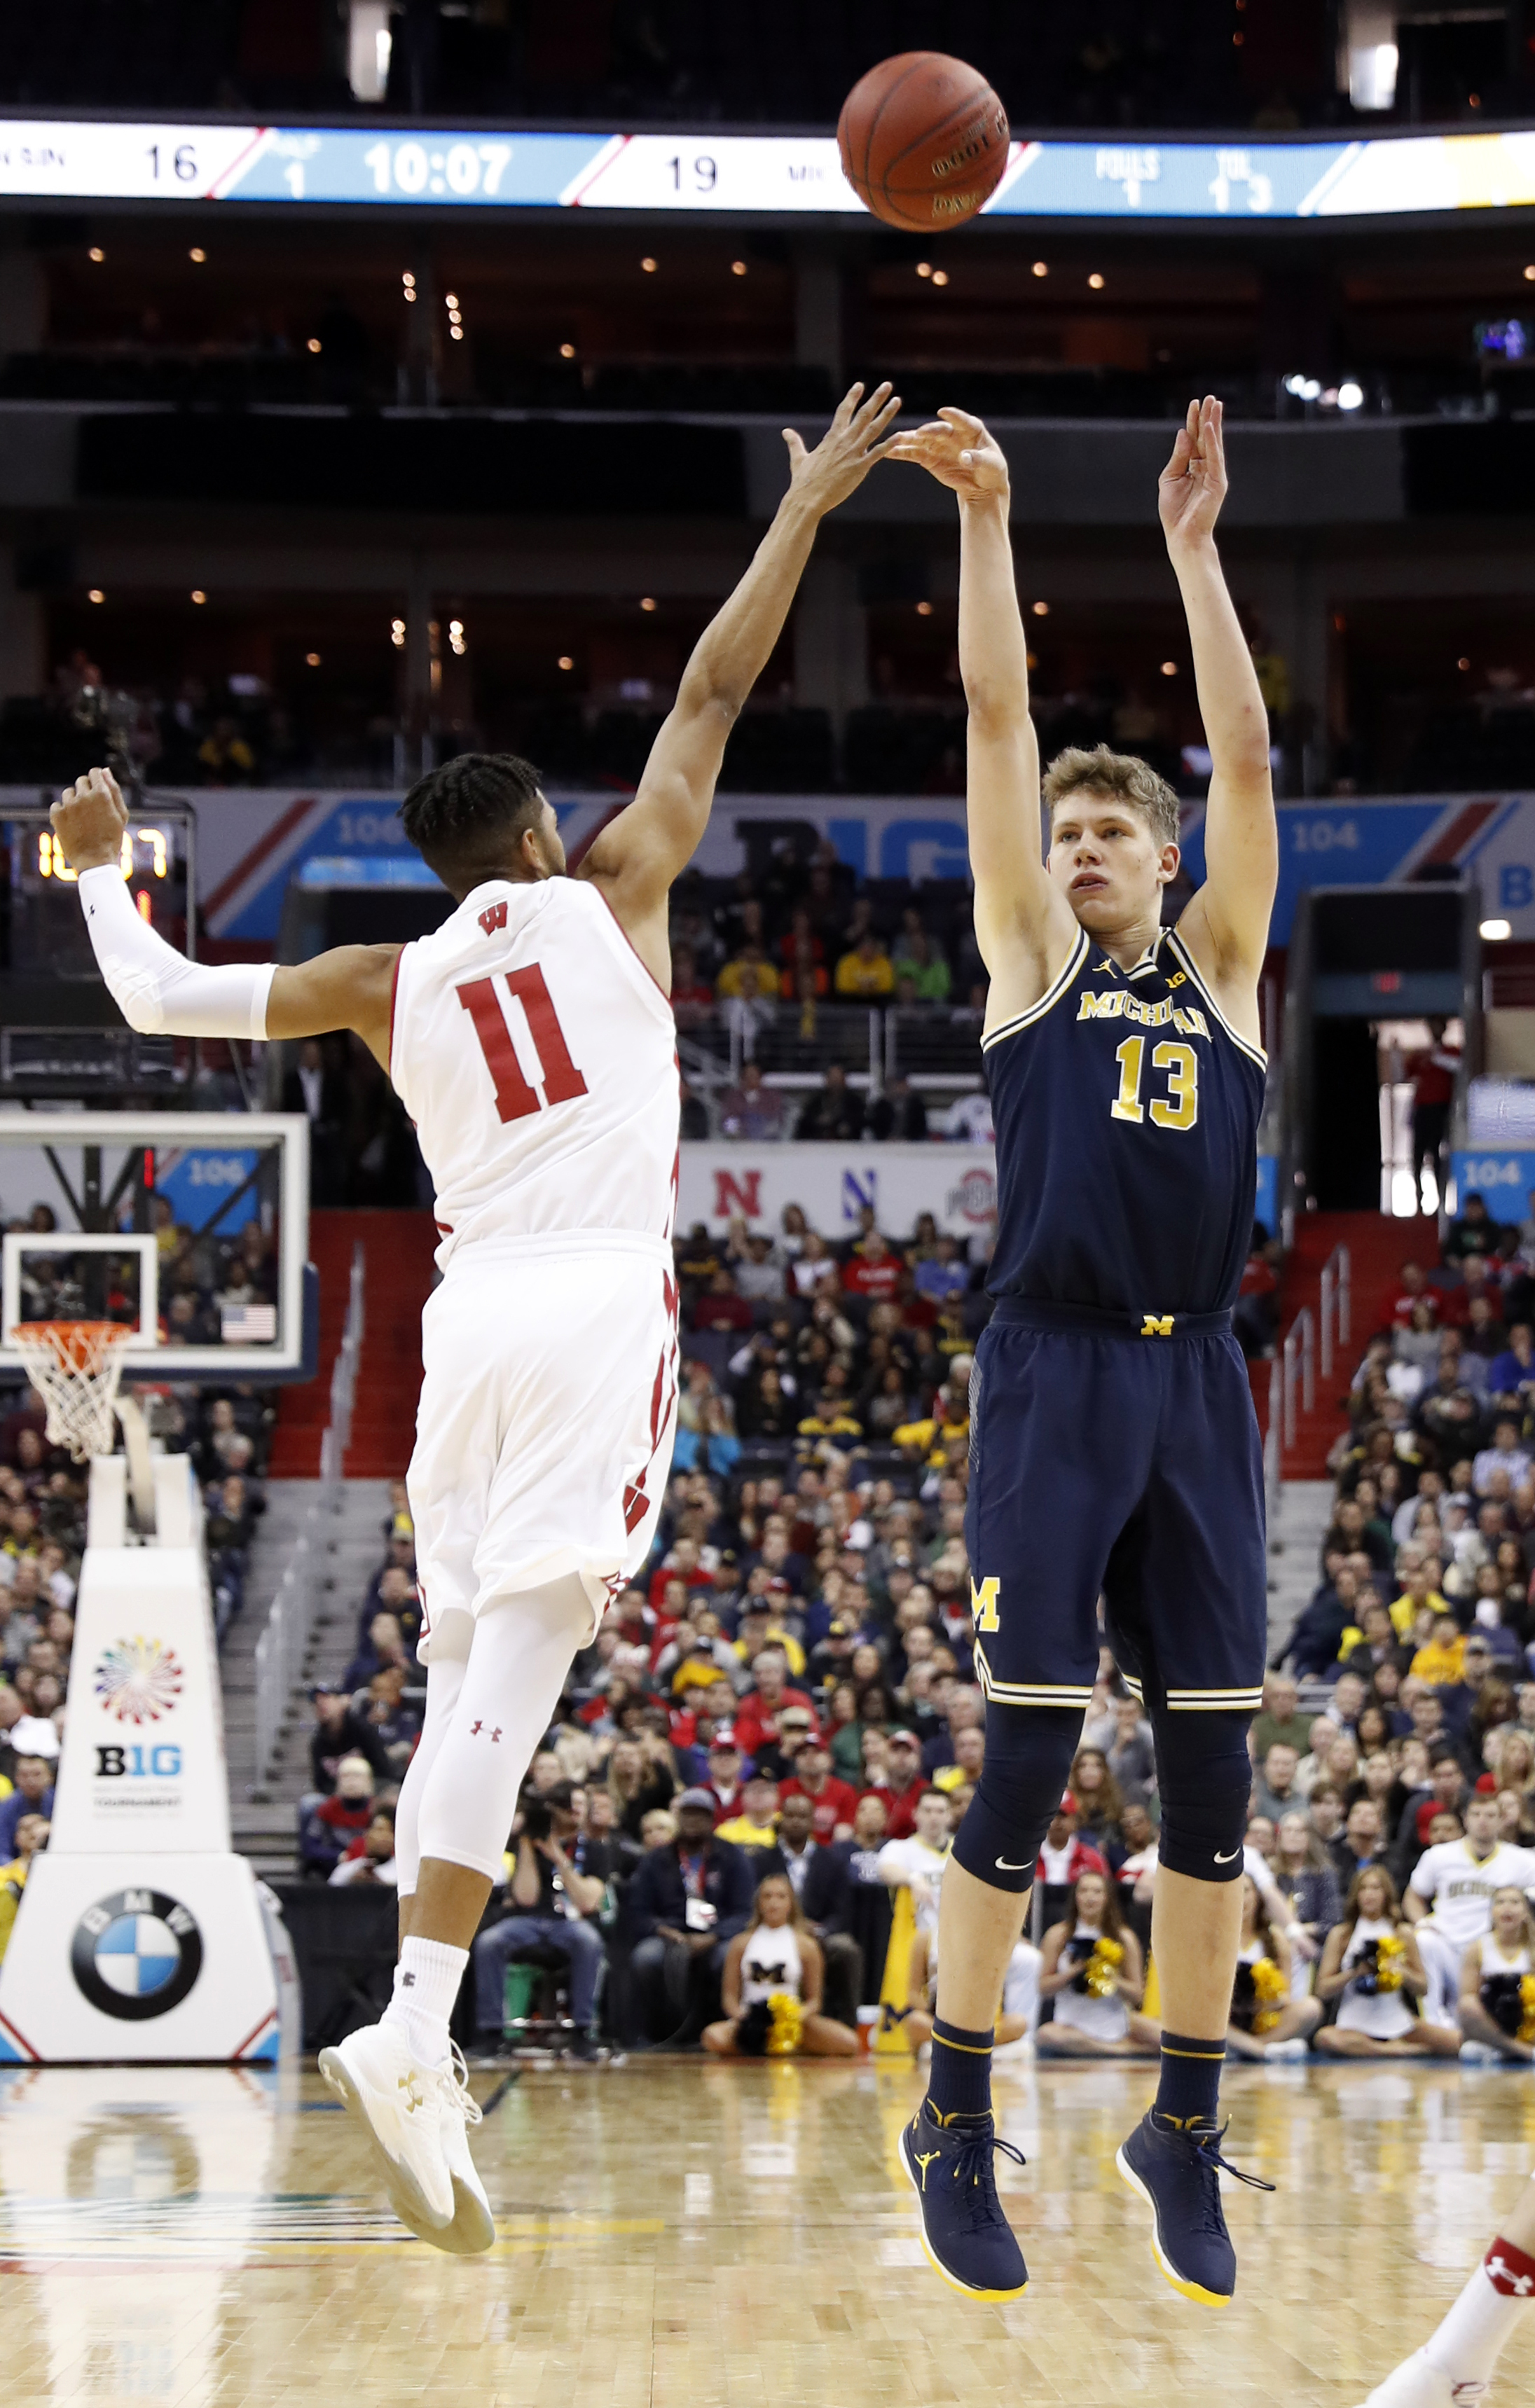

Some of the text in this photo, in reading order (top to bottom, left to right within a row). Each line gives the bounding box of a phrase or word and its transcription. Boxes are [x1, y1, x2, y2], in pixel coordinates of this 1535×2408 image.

[146, 144, 198, 181] 16
[364, 142, 512, 195] 10:07
[668, 155, 717, 192] 19
[1292, 819, 1358, 851] 104
[455, 962, 588, 1125] 11
[1110, 1035, 1197, 1130] 13
[1464, 1160, 1520, 1187] 104
[1141, 1315, 1175, 1336] M
[82, 1889, 198, 1936] BMW
